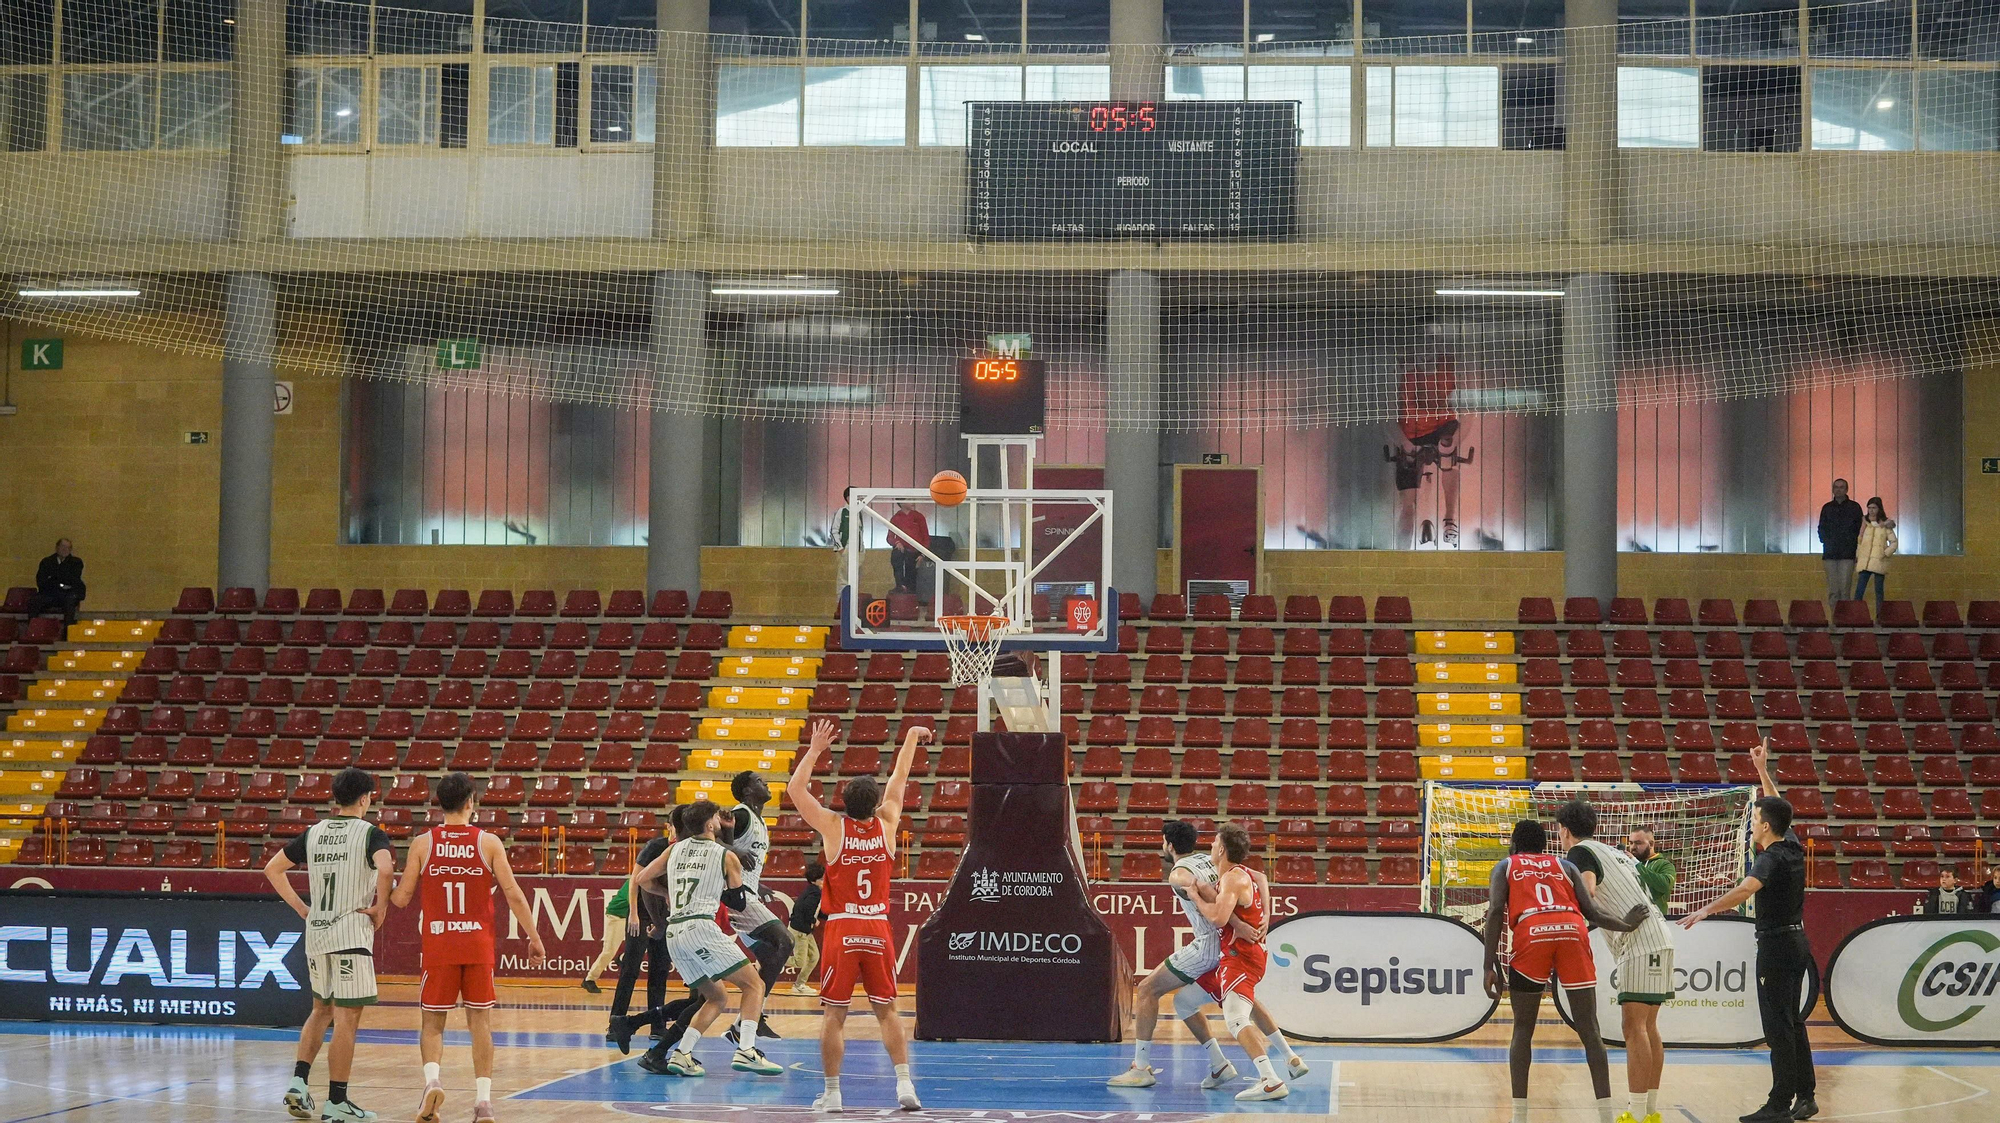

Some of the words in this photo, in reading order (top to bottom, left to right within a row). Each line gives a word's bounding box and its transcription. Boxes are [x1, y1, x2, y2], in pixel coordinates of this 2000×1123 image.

[1091, 107, 1155, 131] 05:5
[1052, 141, 1097, 153] LOCAL
[1168, 141, 1214, 153] VISITANTE
[1052, 223, 1084, 232] FALTAS
[1231, 223, 1241, 231] 15
[33, 344, 50, 365] K
[451, 344, 465, 364] L
[999, 339, 1020, 360] M
[975, 361, 1017, 380] 05:5
[318, 833, 347, 846] OROZCO
[326, 852, 348, 863] RAHI
[436, 841, 475, 859] DÍDAC
[857, 868, 872, 900] 5
[1002, 871, 1064, 883] AYUNTAMIENTO
[442, 881, 465, 915] 11
[675, 877, 700, 909] 27
[1002, 885, 1012, 896] DE
[1535, 882, 1554, 906] 0
[447, 921, 483, 931] IXMA
[980, 931, 1082, 954] IMDECO
[500, 954, 591, 975] Muicipal
[948, 954, 976, 962] Instituto
[977, 955, 1010, 964] Municipal
[1021, 956, 1051, 965] Deportes
[1303, 954, 1473, 1005] Sepisur
[50, 996, 71, 1011] NI
[76, 994, 128, 1016] MÁS,
[133, 998, 155, 1012] NI
[160, 998, 236, 1016] MENOS
[1701, 998, 1718, 1008] the
[1721, 999, 1745, 1008] cold
